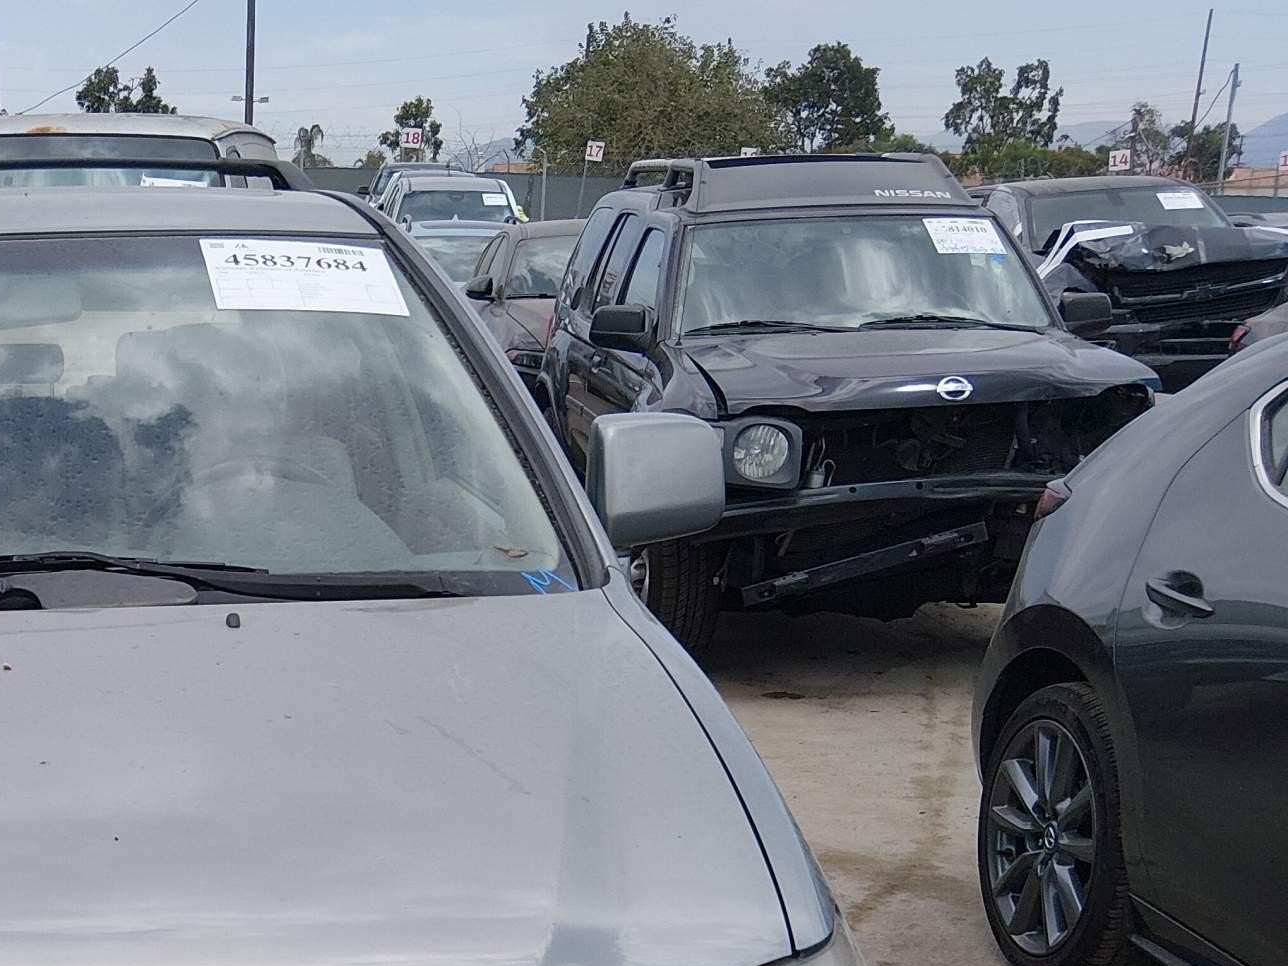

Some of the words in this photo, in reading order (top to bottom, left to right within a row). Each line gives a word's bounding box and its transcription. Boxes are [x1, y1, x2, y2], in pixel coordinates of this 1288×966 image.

[402, 131, 420, 145] 18
[586, 143, 603, 157] 17
[1111, 153, 1129, 167] 14
[873, 189, 952, 199] NISSAN
[224, 253, 369, 272] 45837684
